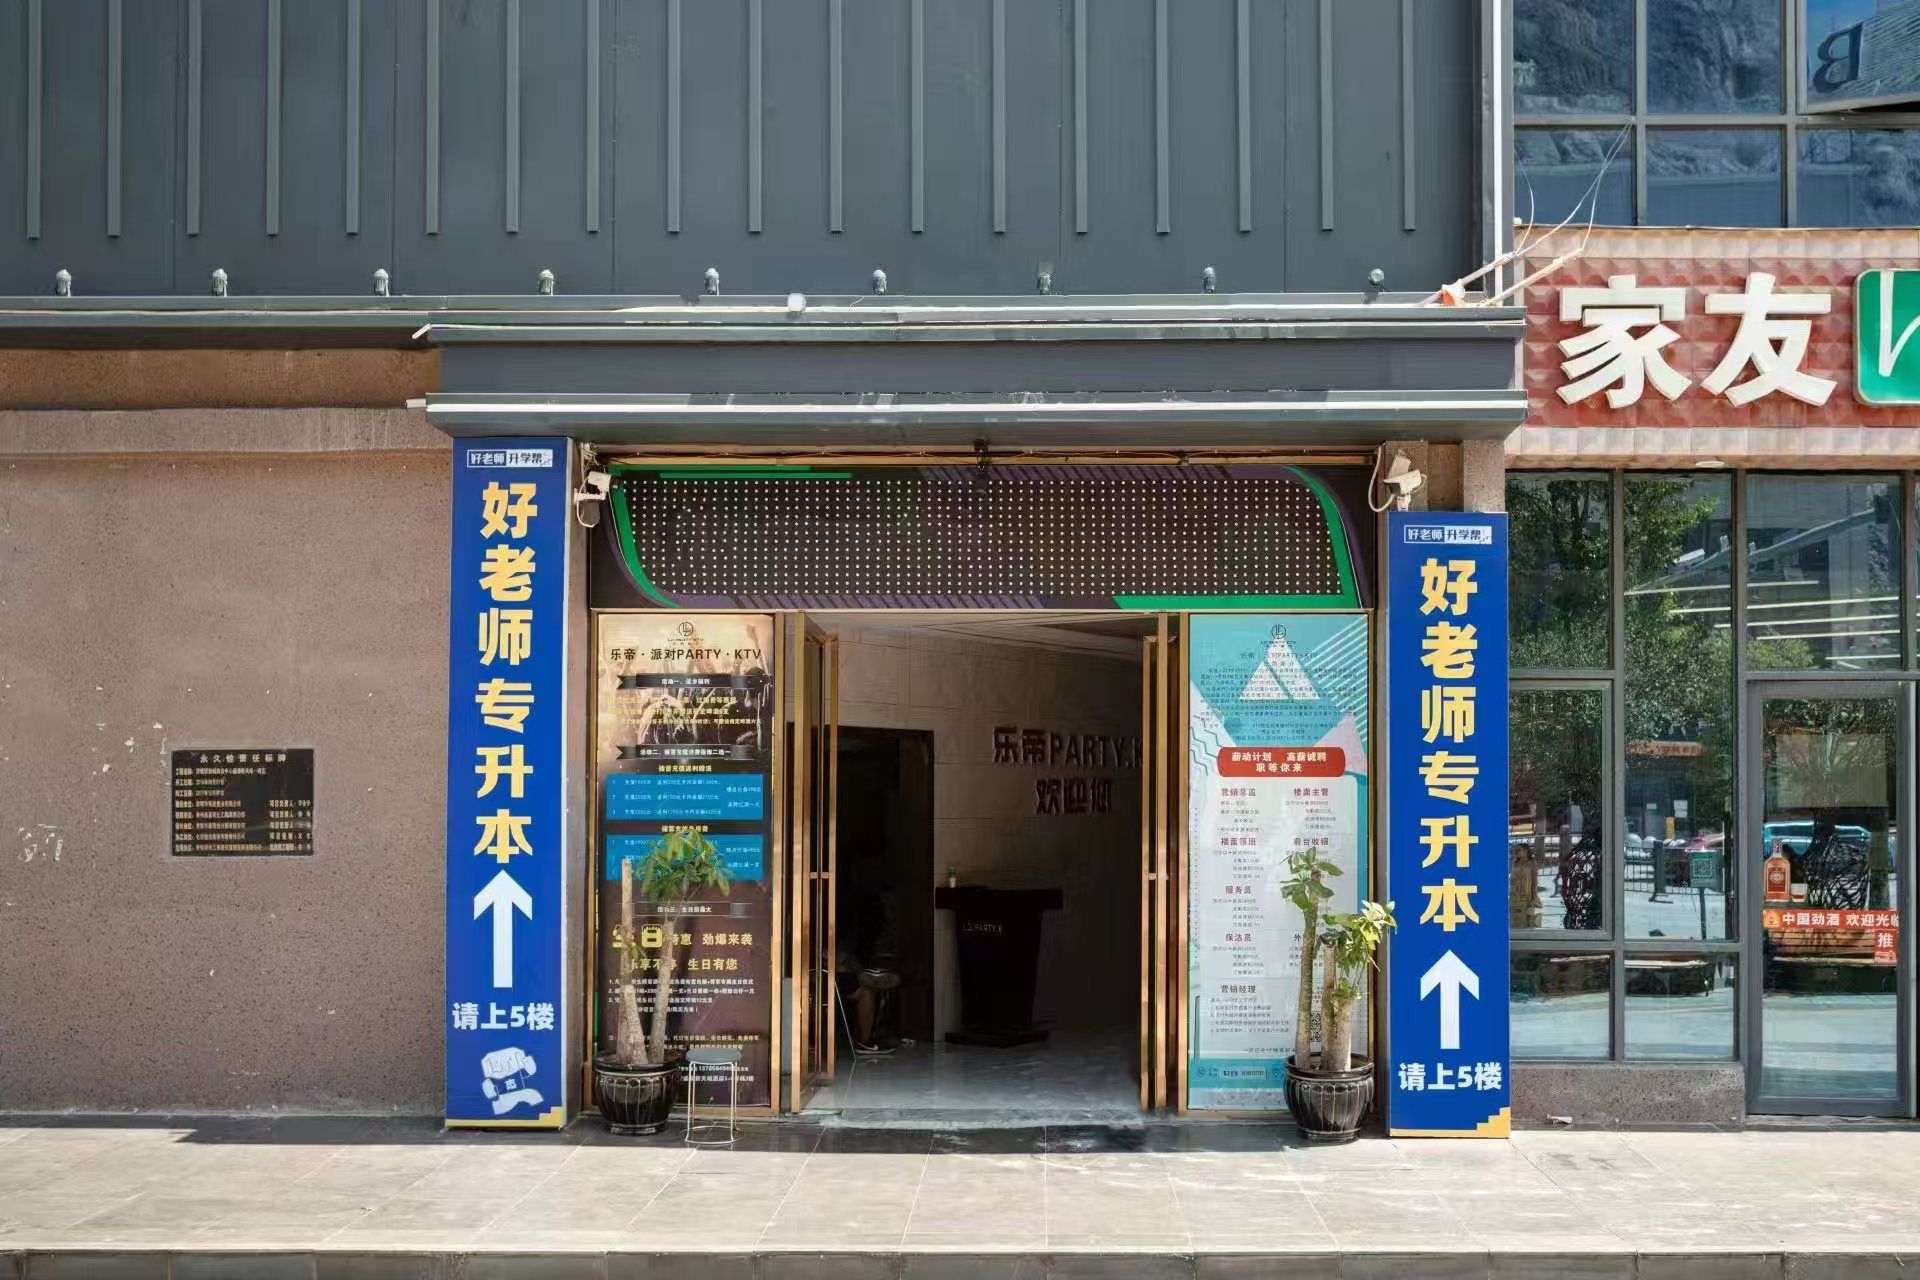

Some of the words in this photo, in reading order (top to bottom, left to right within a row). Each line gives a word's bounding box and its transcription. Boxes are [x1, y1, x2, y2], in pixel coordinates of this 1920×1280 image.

[1556, 272, 1838, 408] 家友
[470, 452, 506, 465] 好老师
[1407, 528, 1443, 541] 好老师
[474, 481, 538, 864] 好老师专升本
[1418, 557, 1480, 932] 好老师专升本
[1255, 763, 1303, 773] 职等你来
[1782, 912, 1840, 927] 中国劲酒
[702, 932, 753, 946] 劲爆来袭
[1877, 932, 1893, 948] 推
[687, 958, 738, 971] 生日有您
[452, 1002, 555, 1031] 请上5楼
[1398, 1062, 1503, 1091] 请上5楼
